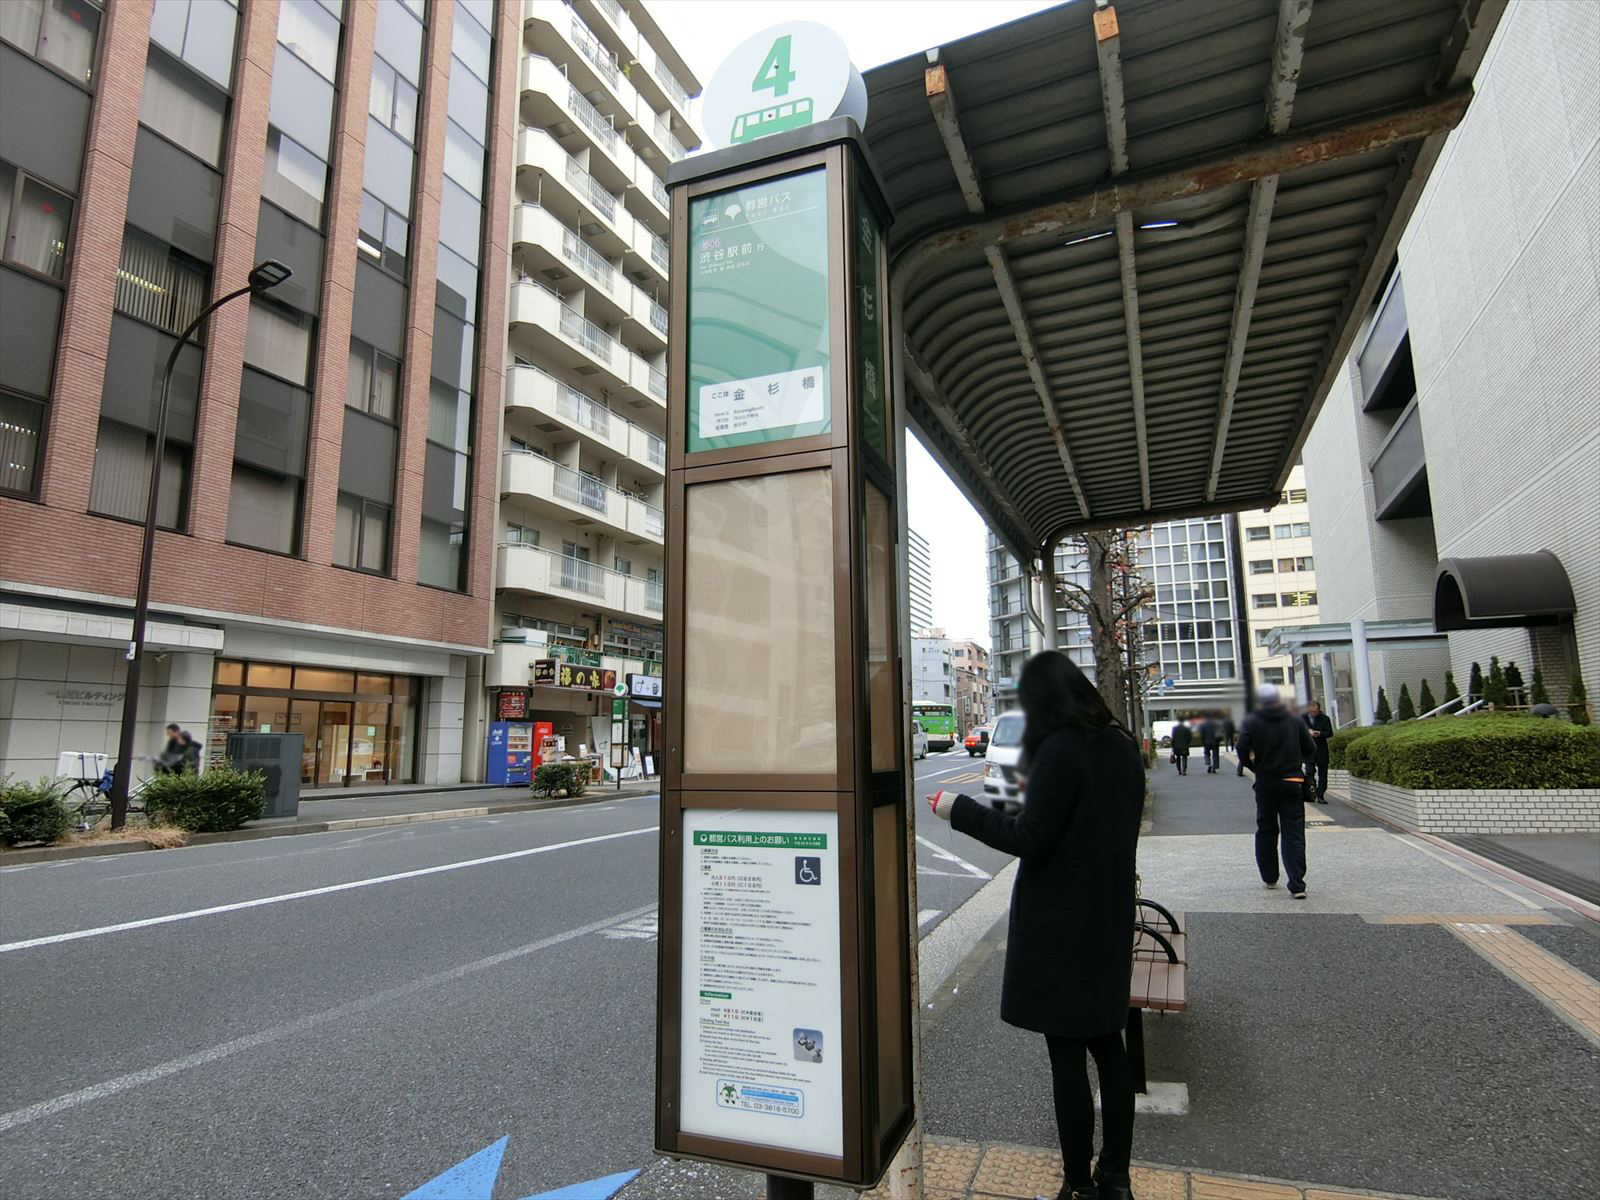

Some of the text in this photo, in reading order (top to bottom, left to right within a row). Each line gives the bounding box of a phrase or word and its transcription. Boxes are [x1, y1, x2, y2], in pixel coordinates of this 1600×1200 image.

[751, 34, 796, 98] 4
[745, 191, 791, 211] 都営バス
[700, 243, 765, 264] 渋谷駅前 行
[711, 375, 816, 401] ここは 金杉橋
[709, 834, 790, 845] 都営バス利用上のお願い
